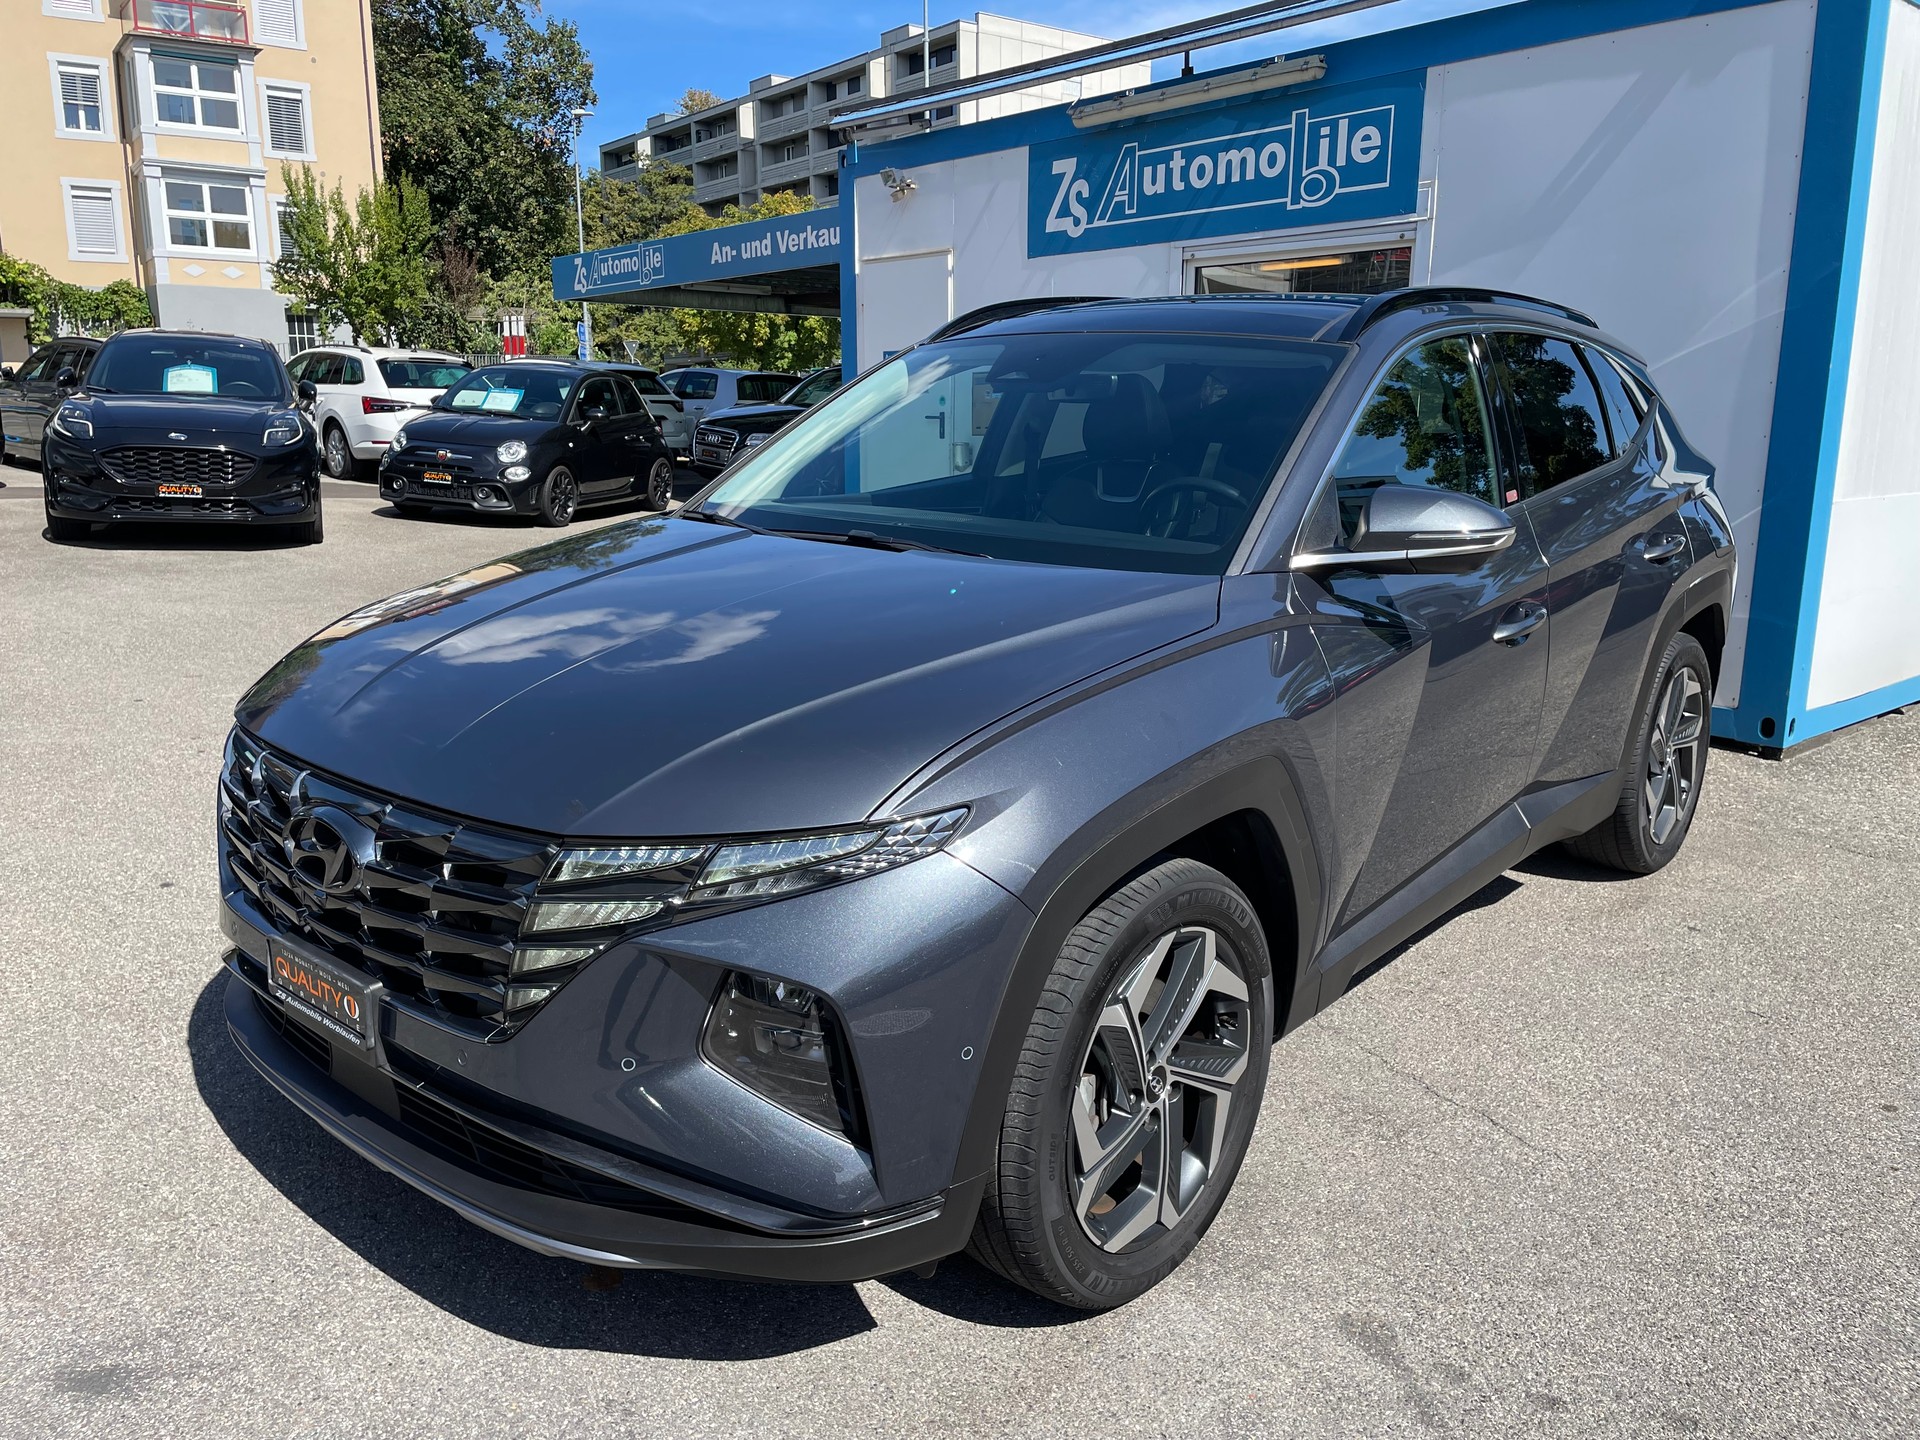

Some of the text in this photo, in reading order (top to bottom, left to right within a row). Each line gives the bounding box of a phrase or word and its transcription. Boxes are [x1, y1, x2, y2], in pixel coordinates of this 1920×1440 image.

[1094, 108, 1382, 224] Automobile
[588, 244, 662, 287] Automobile
[711, 242, 737, 264] An-
[741, 232, 771, 259] und
[286, 995, 323, 1022] Automobile
[323, 1017, 361, 1046] Worblaufen
